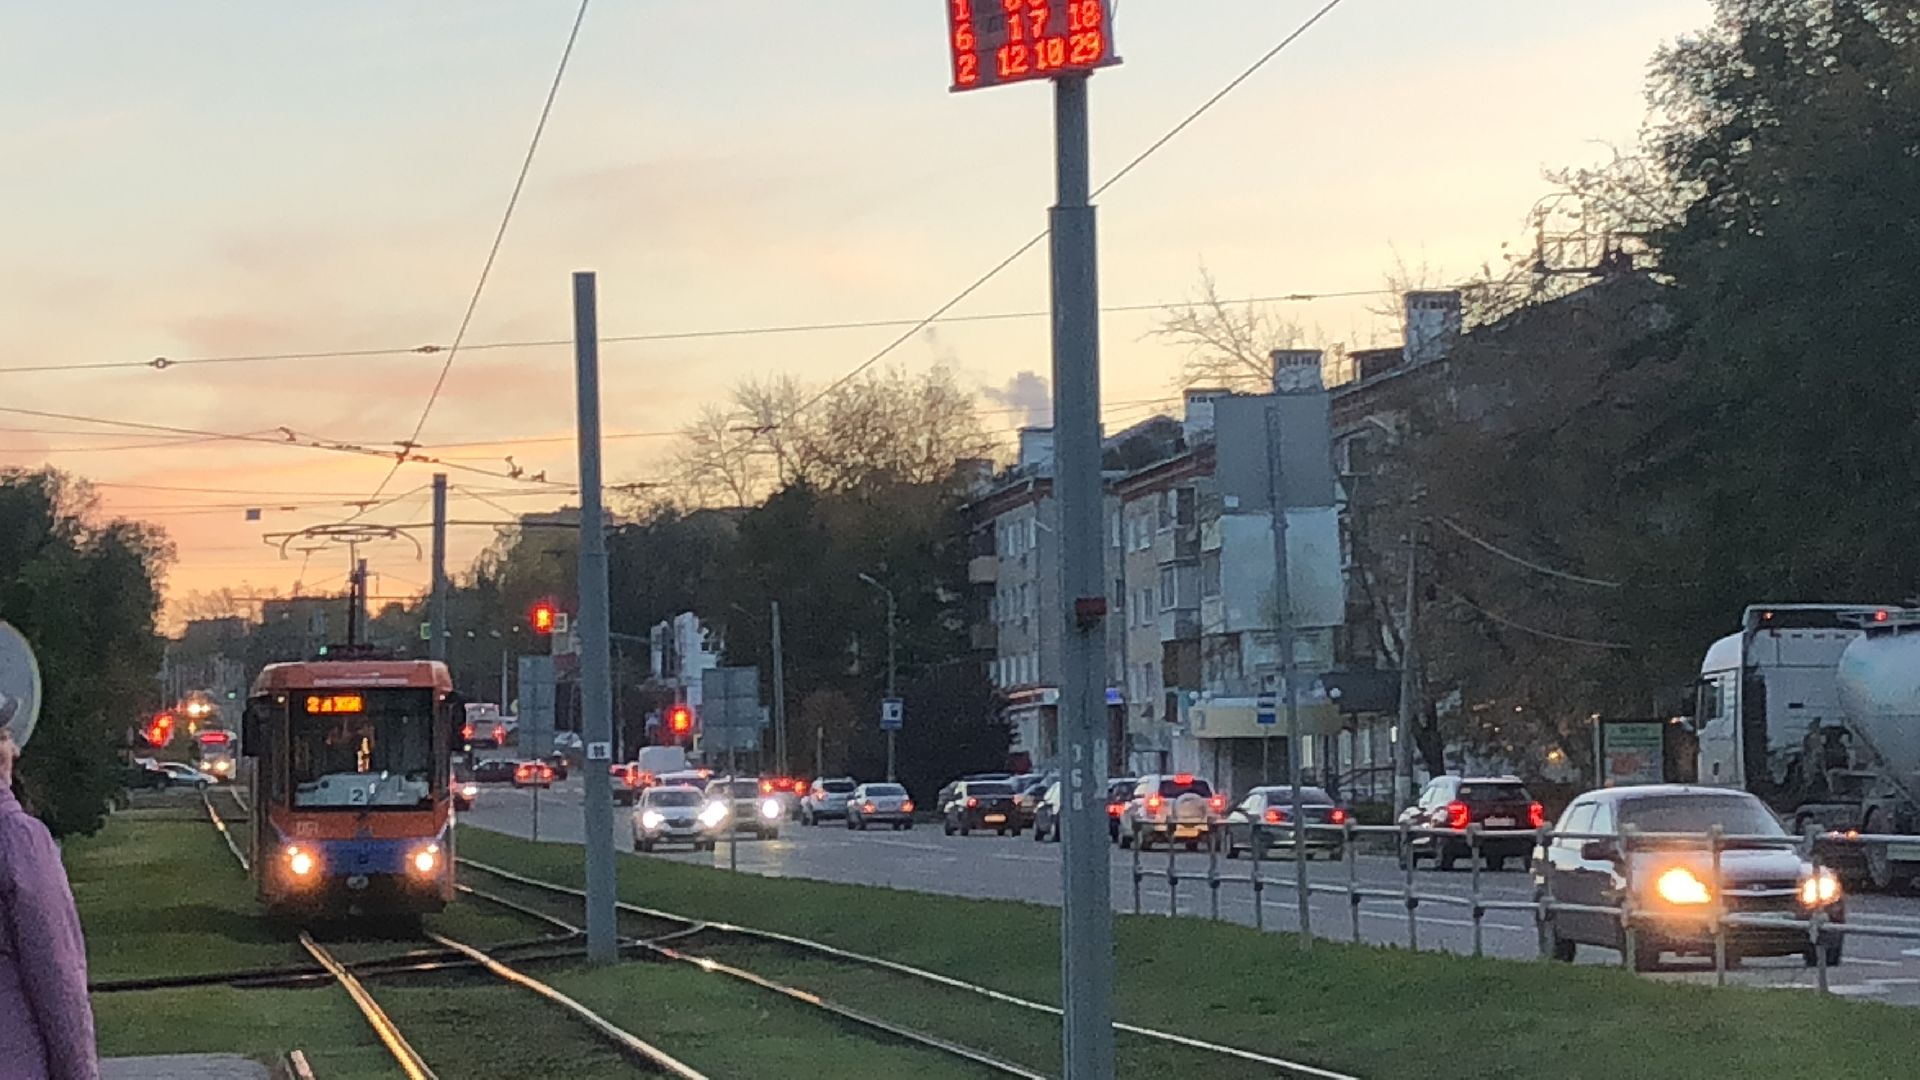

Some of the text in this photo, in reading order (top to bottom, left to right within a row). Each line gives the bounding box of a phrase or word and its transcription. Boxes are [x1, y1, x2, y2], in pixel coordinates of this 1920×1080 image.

[955, 23, 974, 51] 6
[1007, 13, 1023, 42] 1
[1027, 7, 1048, 39] 7
[958, 30, 1101, 83] 2 12 10 29
[352, 789, 364, 802] 2
